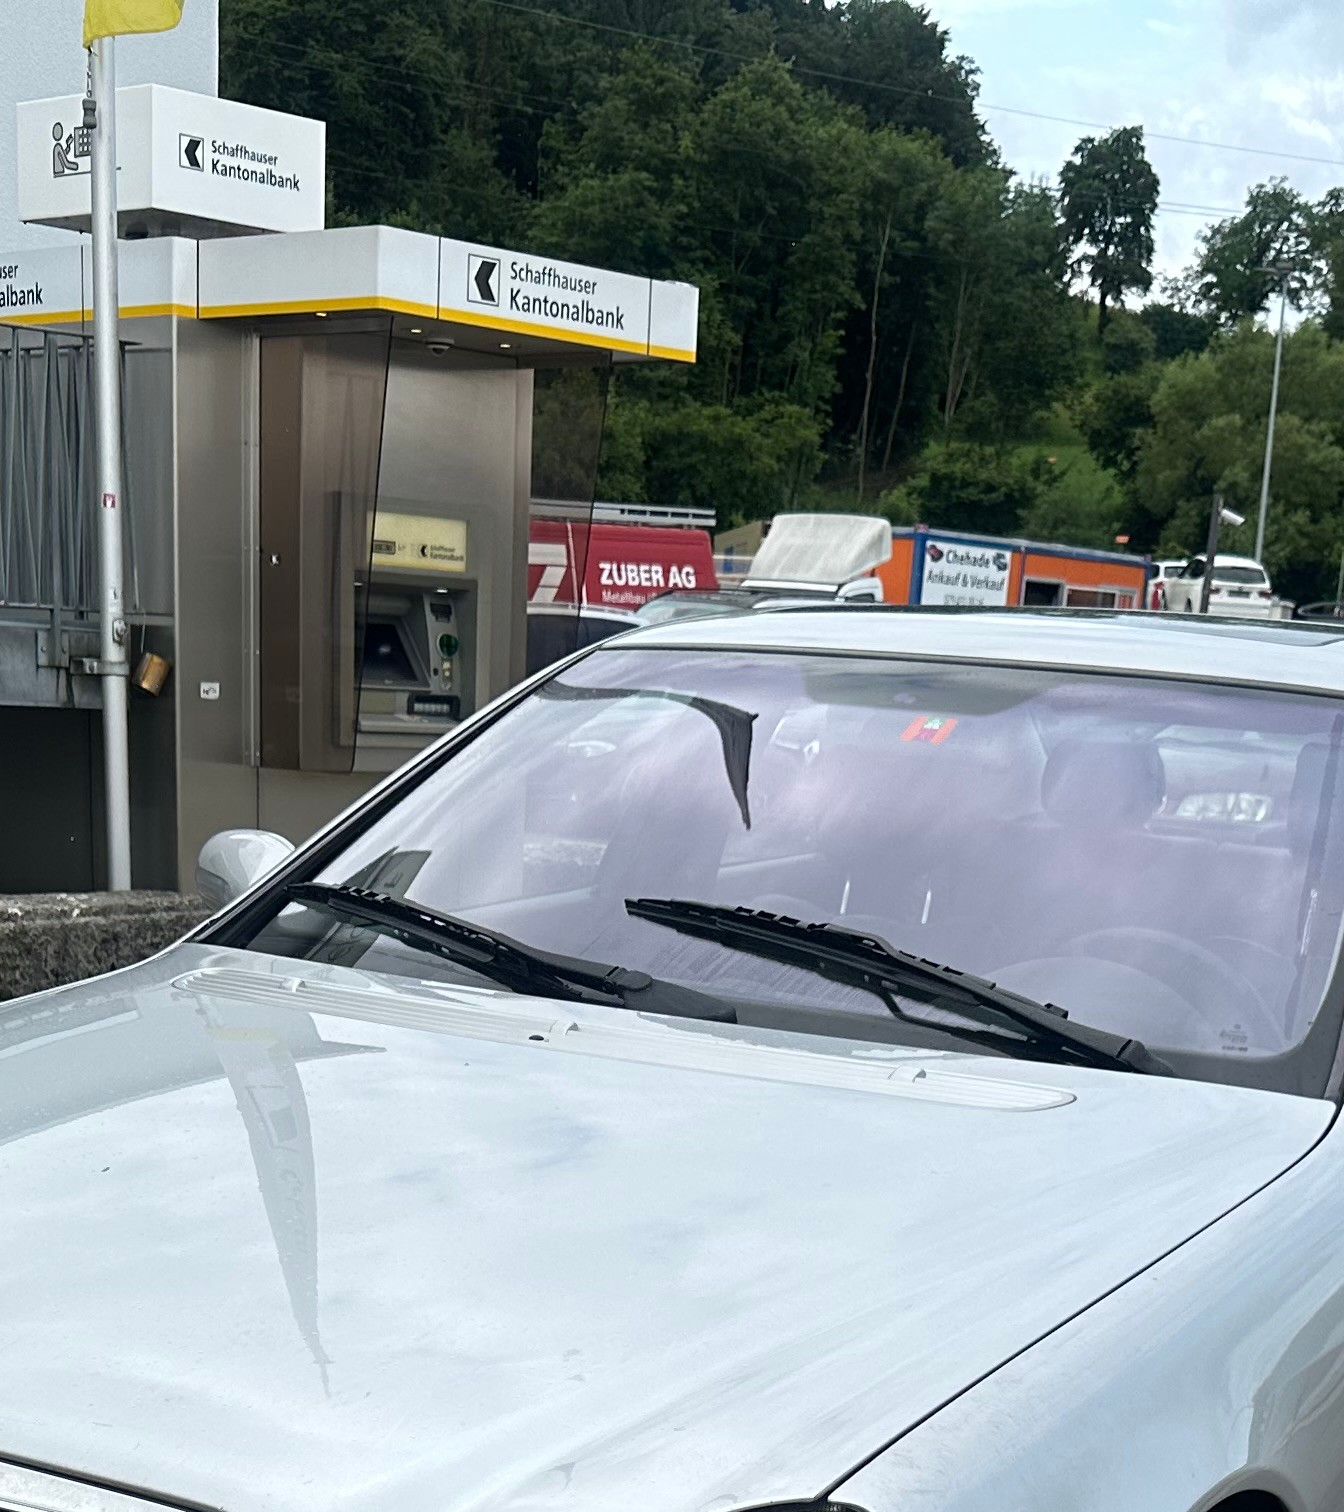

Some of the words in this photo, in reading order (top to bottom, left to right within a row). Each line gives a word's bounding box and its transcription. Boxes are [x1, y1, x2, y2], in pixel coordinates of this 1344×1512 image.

[211, 139, 278, 167] Schaffhauser
[211, 157, 301, 192] Kantonalbank
[510, 261, 598, 295] Schaffhauser
[509, 287, 625, 331] Kantonalbank
[599, 561, 665, 588] ZUBER
[668, 565, 696, 588] AG
